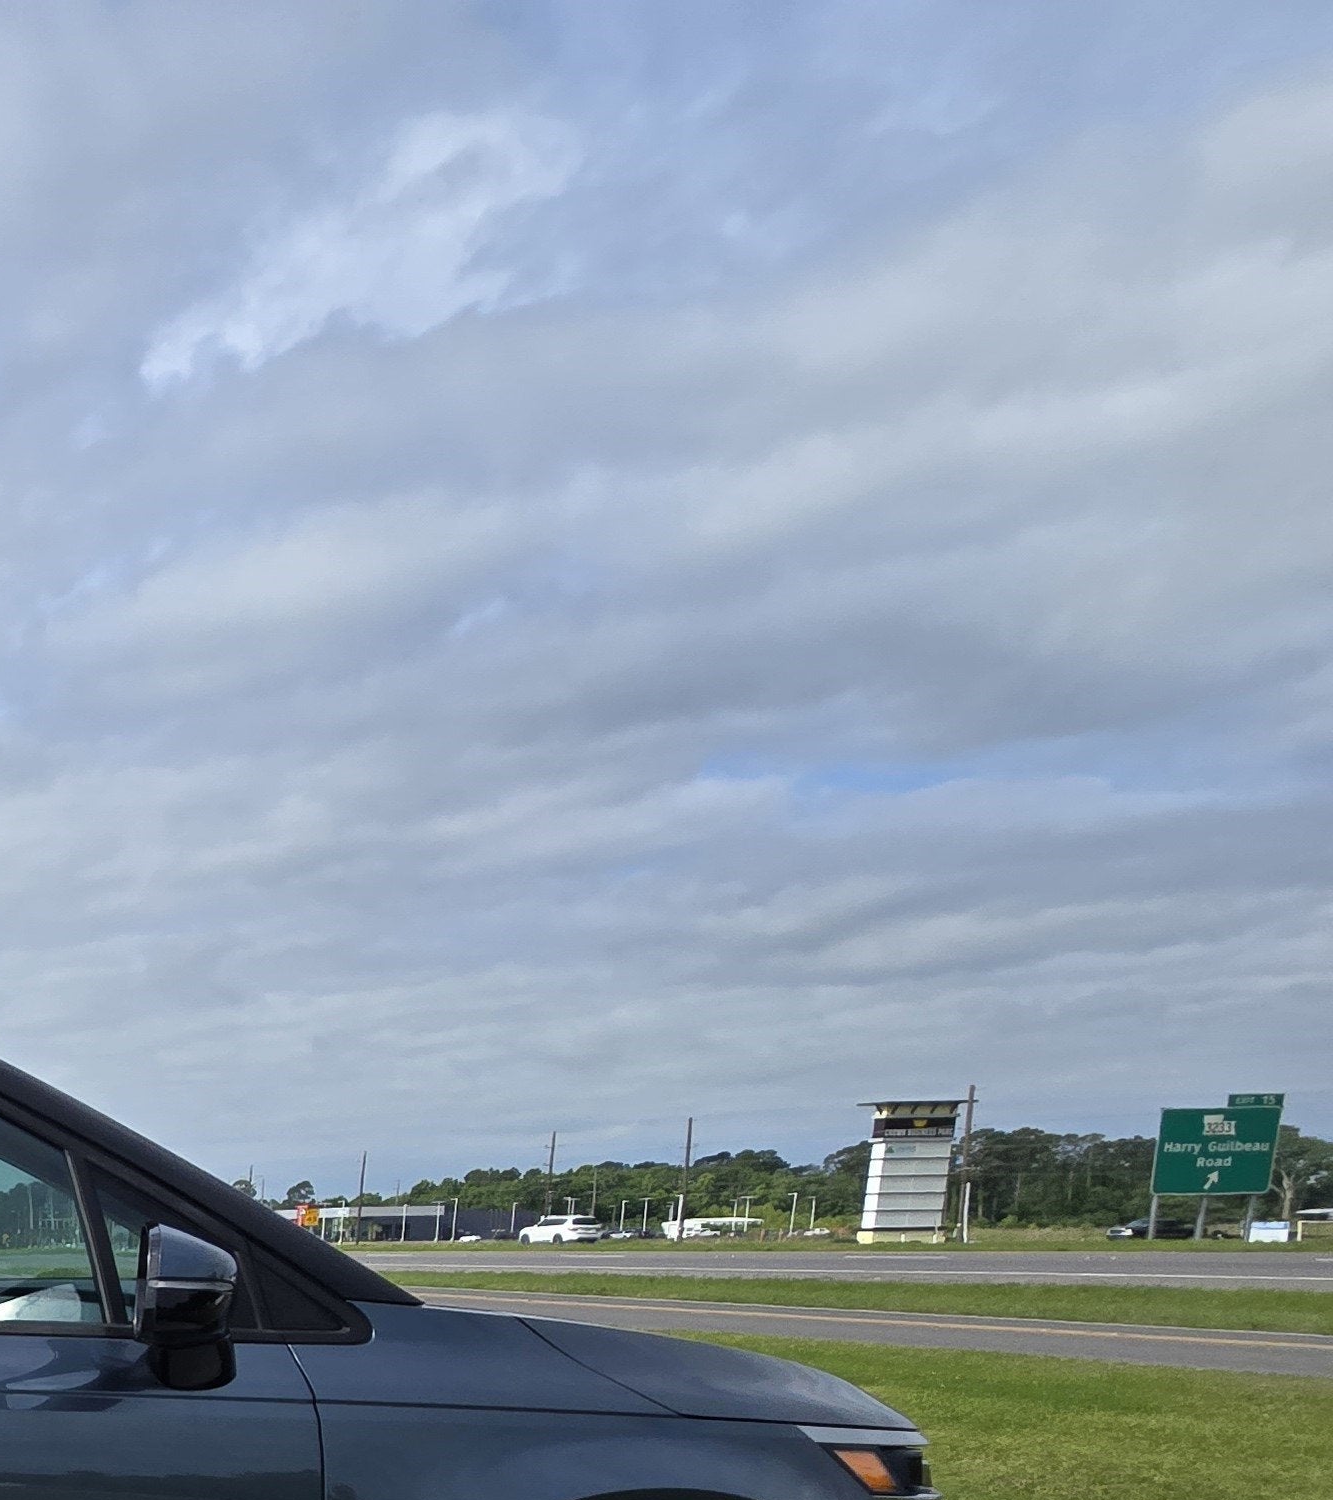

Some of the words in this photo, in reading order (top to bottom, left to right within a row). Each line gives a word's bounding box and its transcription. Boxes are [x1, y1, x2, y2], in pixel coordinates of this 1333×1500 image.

[1262, 1095, 1276, 1105] 15
[1205, 1122, 1232, 1134] 3233
[1163, 1141, 1202, 1155] Harry
[1196, 1156, 1232, 1168] Road
